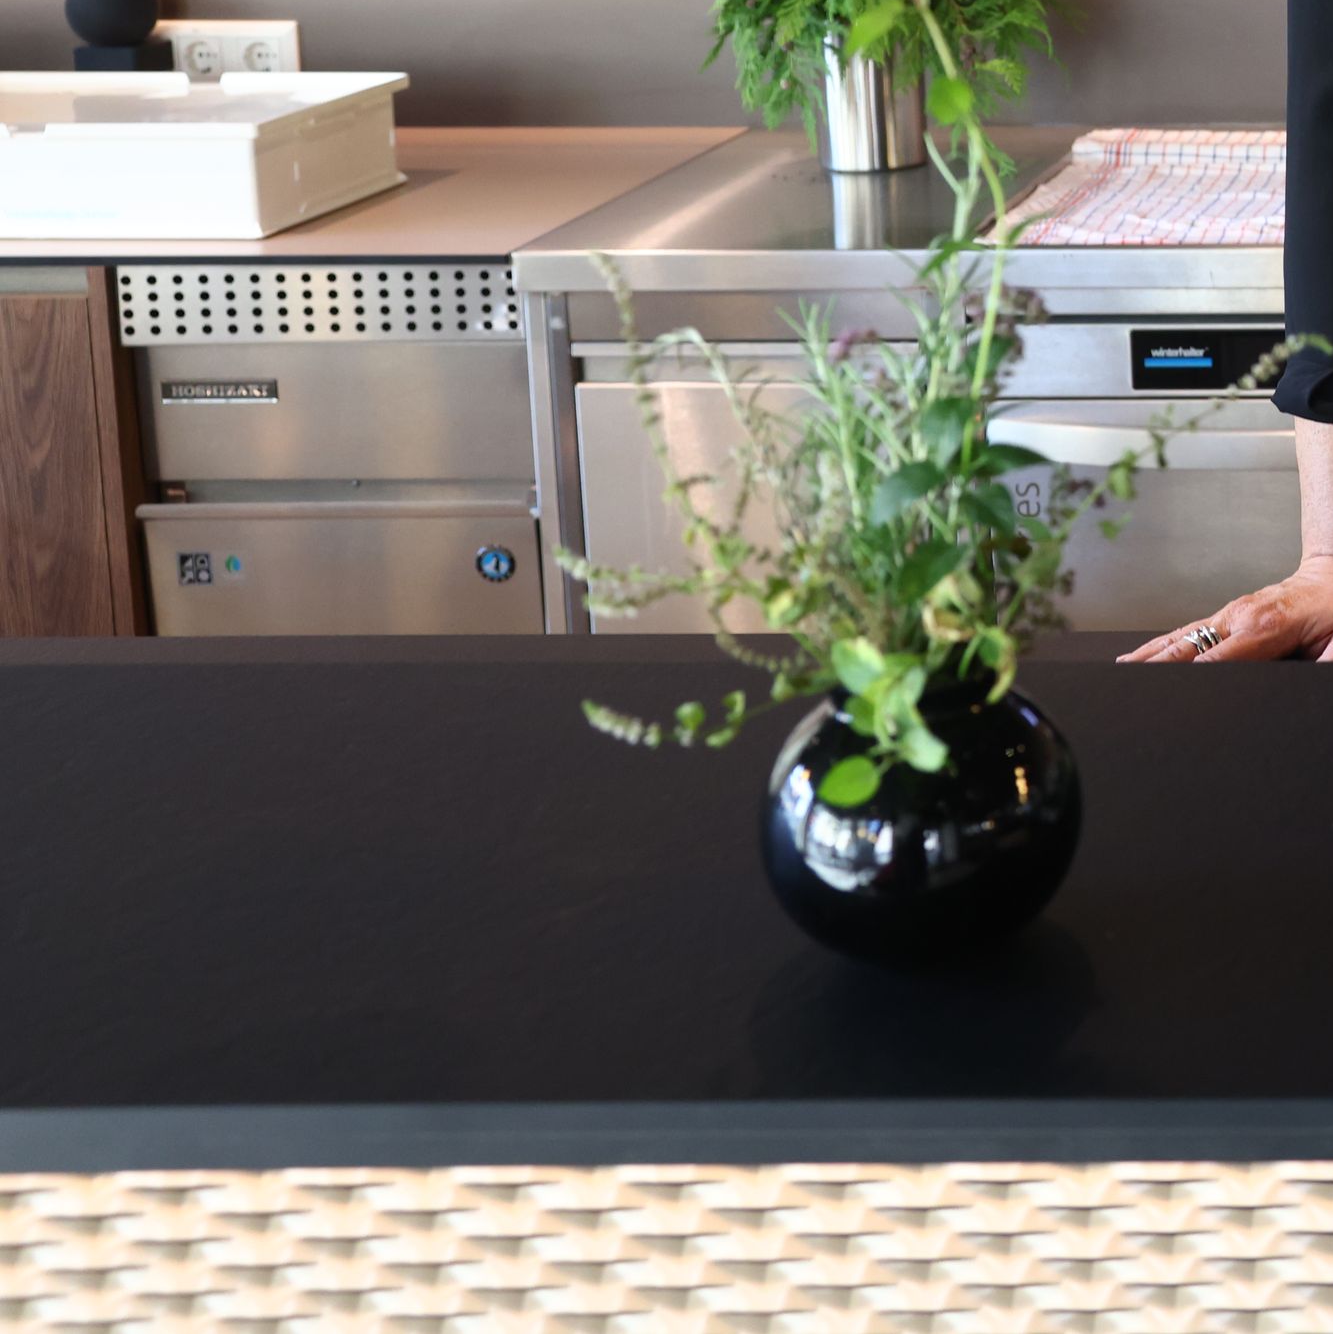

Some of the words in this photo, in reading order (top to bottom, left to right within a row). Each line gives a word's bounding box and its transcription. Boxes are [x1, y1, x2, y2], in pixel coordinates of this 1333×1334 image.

[1150, 346, 1205, 357] winterhalter
[172, 385, 268, 397] HOSHIZAKI
[1015, 482, 1041, 517] es
